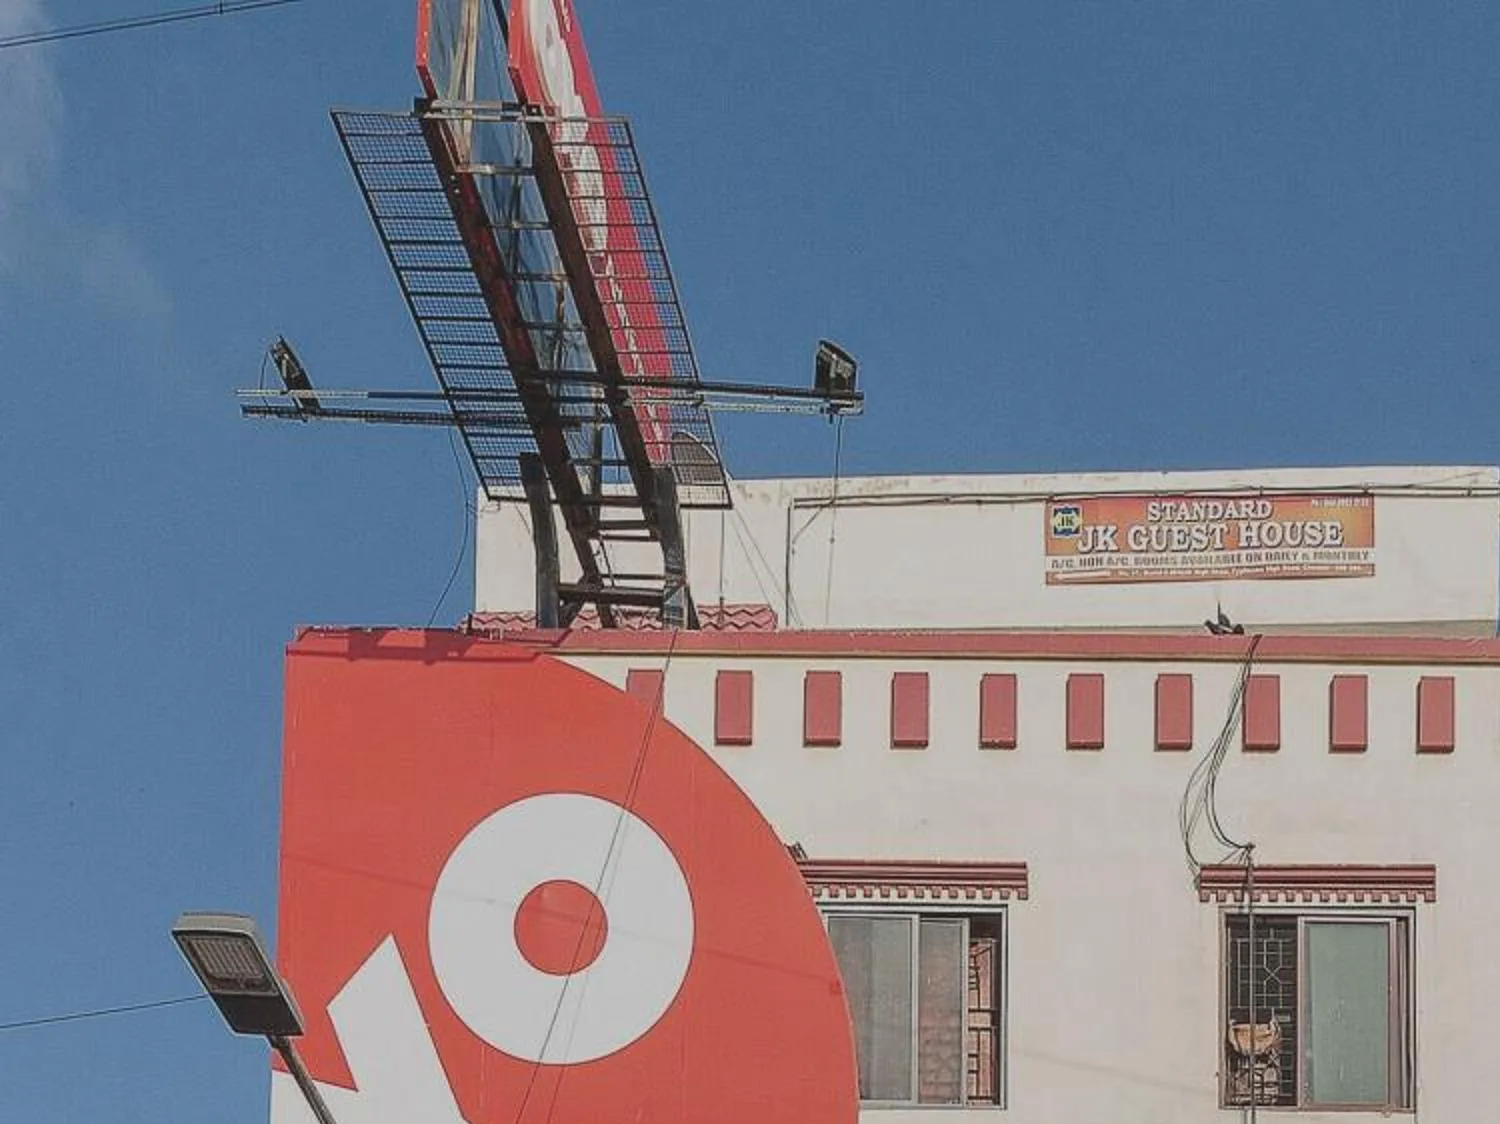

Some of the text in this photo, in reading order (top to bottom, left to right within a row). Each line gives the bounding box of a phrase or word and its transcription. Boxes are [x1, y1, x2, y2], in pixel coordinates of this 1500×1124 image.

[1147, 501, 1274, 522] STANDARD
[1077, 521, 1344, 553] JK GUEST HOUSE
[1245, 552, 1262, 563] ON
[1265, 551, 1298, 562] DAILY
